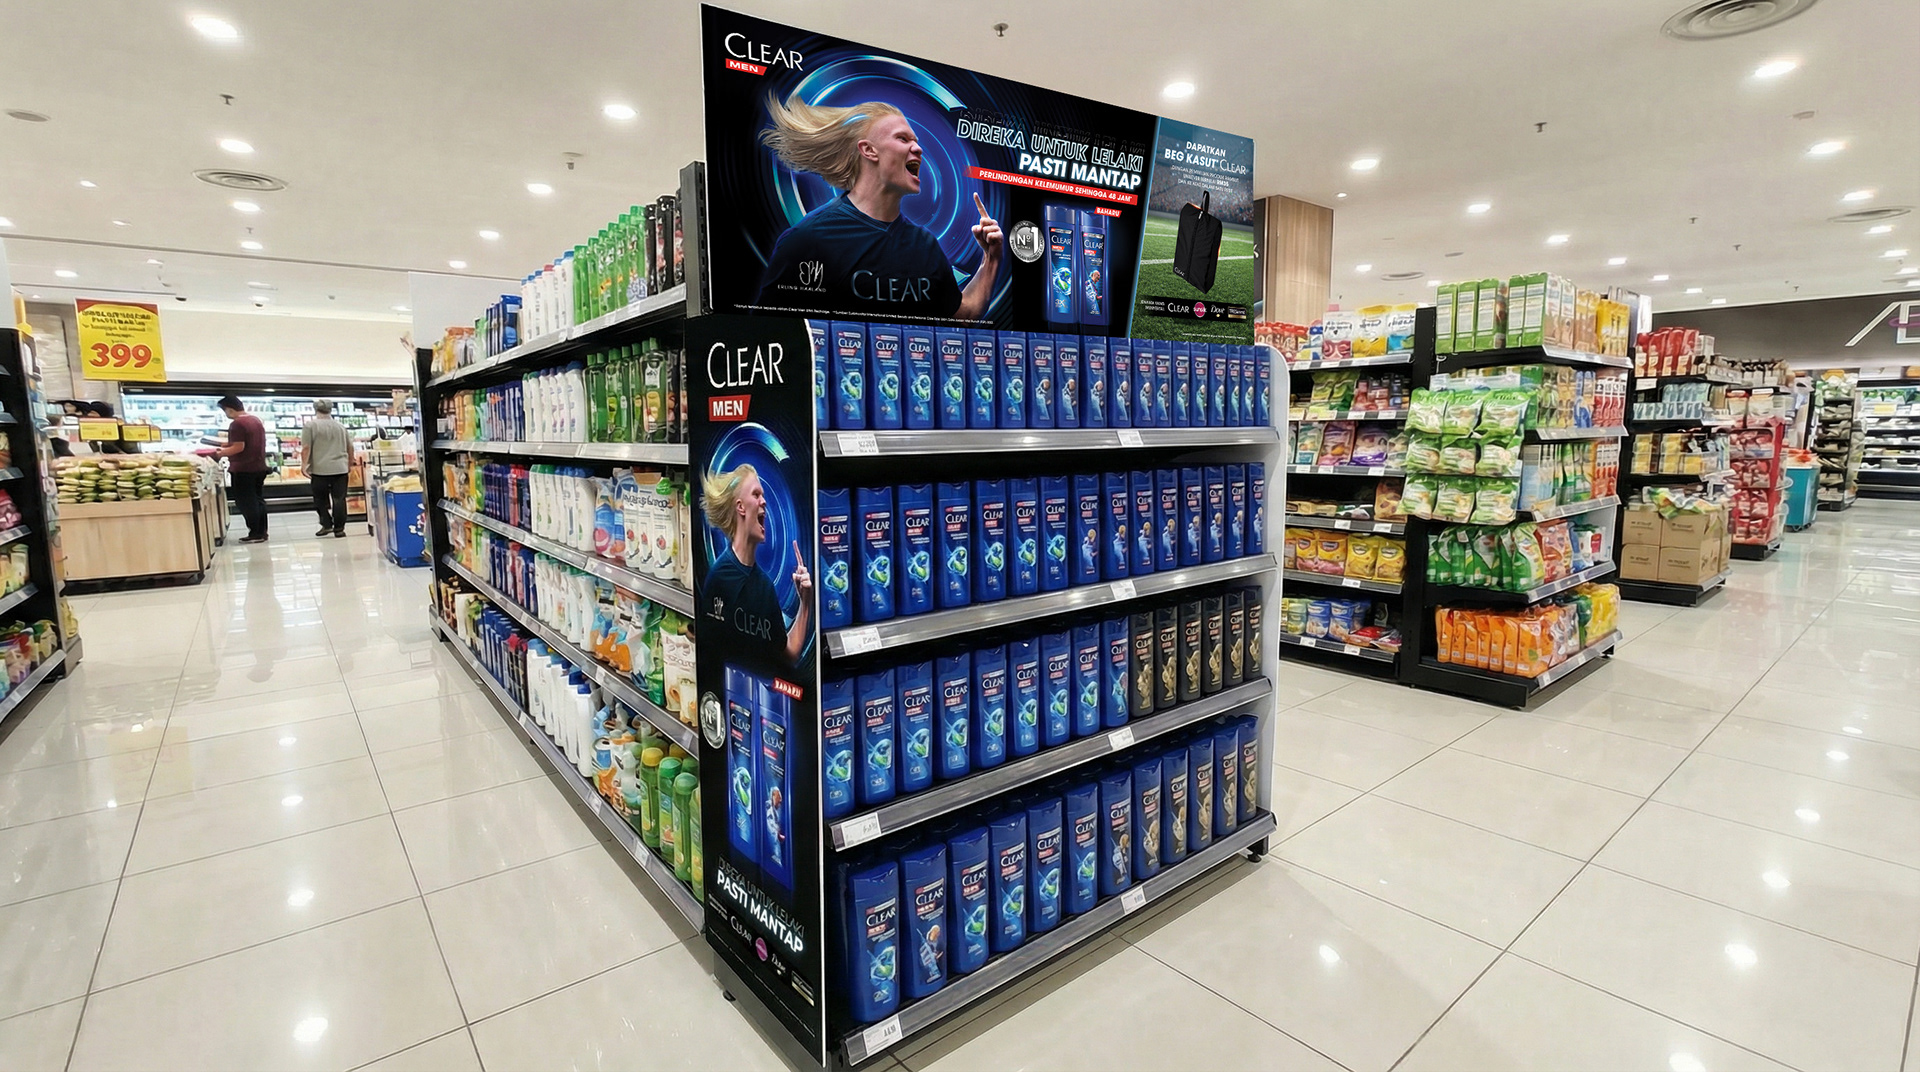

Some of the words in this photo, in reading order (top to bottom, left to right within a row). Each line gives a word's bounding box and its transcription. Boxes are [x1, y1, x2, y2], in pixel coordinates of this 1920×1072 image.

[724, 32, 803, 72] CLEAR
[729, 60, 759, 73] MEN
[957, 118, 1026, 150] DIREKA
[1030, 133, 1088, 162] UNTUK
[1091, 146, 1144, 173] LELAKI
[1186, 141, 1226, 157] DAPATKAN
[1019, 152, 1067, 178] PASTI
[1071, 162, 1142, 191] MANTAP
[1164, 148, 1185, 162] BEG
[1219, 159, 1246, 175] CLEAR
[979, 169, 1034, 186] PERLINDUNGAN
[1034, 177, 1074, 194] KELEMUMUR
[1074, 185, 1107, 199] SEHINGGA
[1107, 192, 1117, 200] 48
[1096, 208, 1120, 217] BAHARU
[851, 269, 931, 302] CLEAR
[1167, 302, 1190, 313] CLEAR
[89, 343, 152, 368] 399
[707, 342, 784, 389] CLEAR
[713, 400, 743, 417] MEN
[734, 607, 771, 641] CLEAR
[916, 887, 944, 906] CLEAR
[717, 869, 748, 909] PASTI
[750, 897, 804, 952] MANTAP
[867, 907, 896, 927] CLEAR
